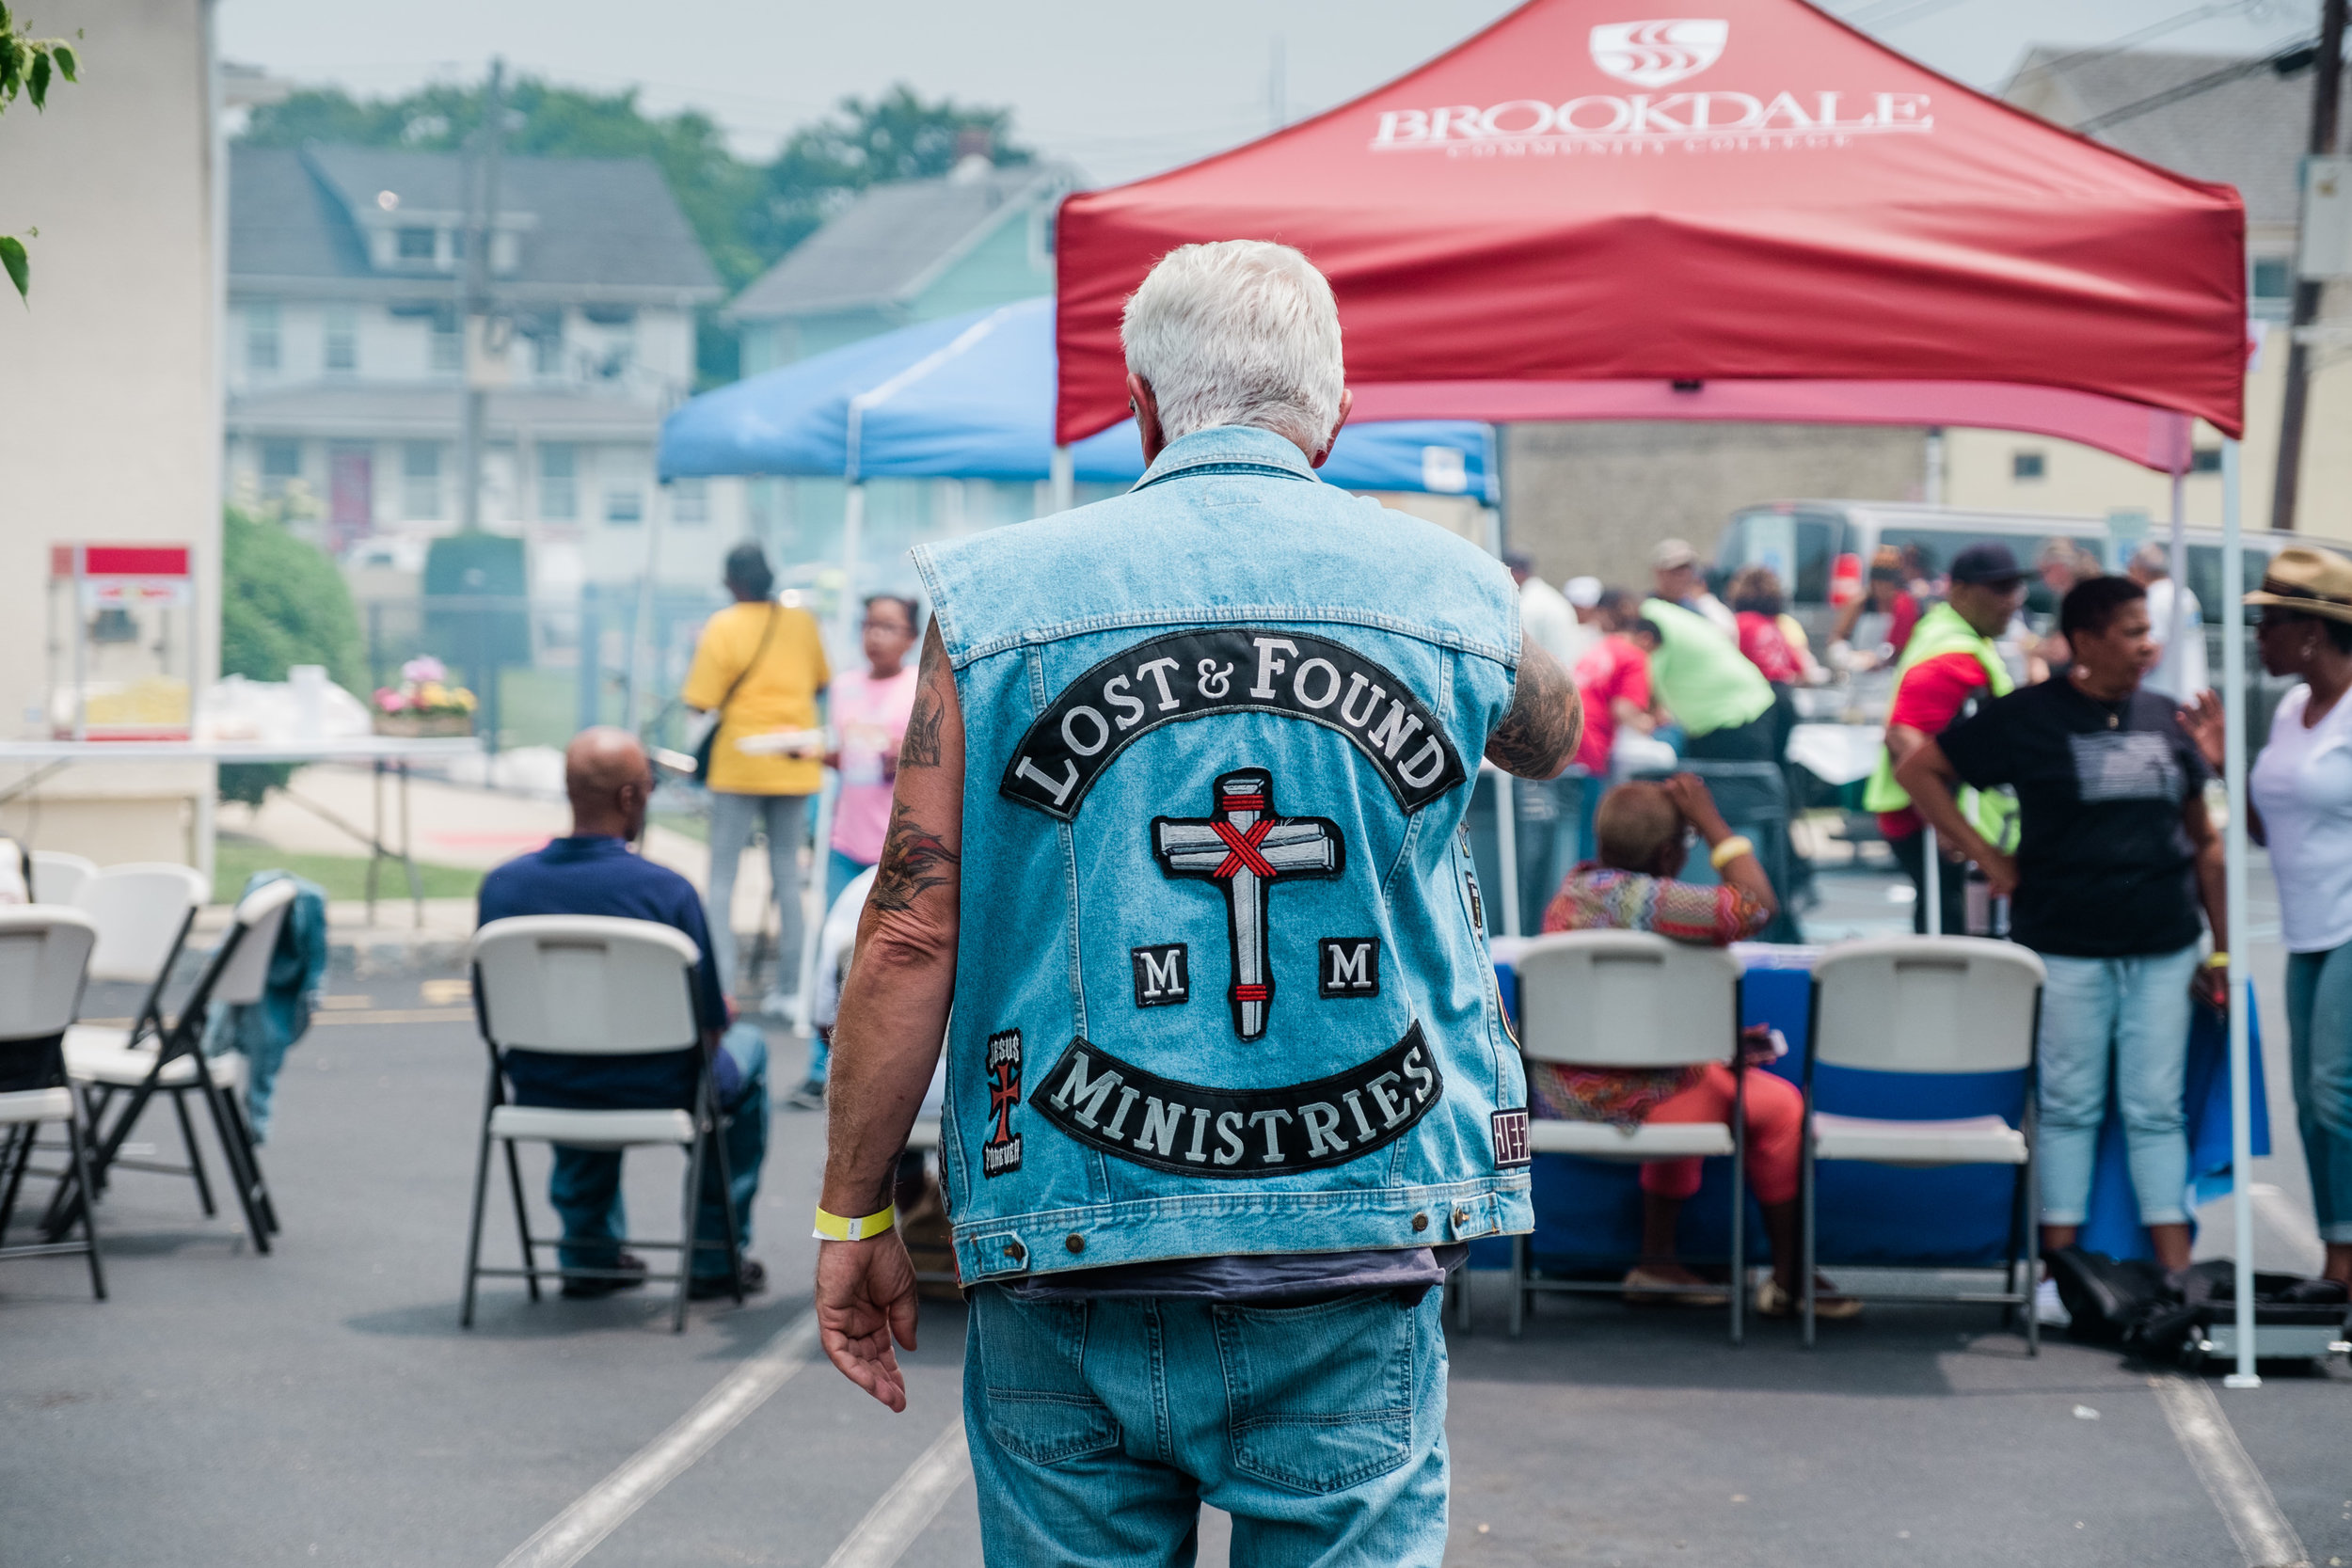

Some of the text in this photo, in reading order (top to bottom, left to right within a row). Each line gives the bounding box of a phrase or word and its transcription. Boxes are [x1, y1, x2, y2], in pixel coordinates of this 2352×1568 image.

[1370, 90, 1934, 150] BROOKDALE
[1015, 637, 1446, 806] LOST & FOUND
[1140, 948, 1185, 999] M
[1327, 943, 1373, 990] M
[990, 1034, 1020, 1069] JESUS
[1050, 1045, 1434, 1165] MINISTRIES
[985, 1138, 1021, 1172] FOREVER
